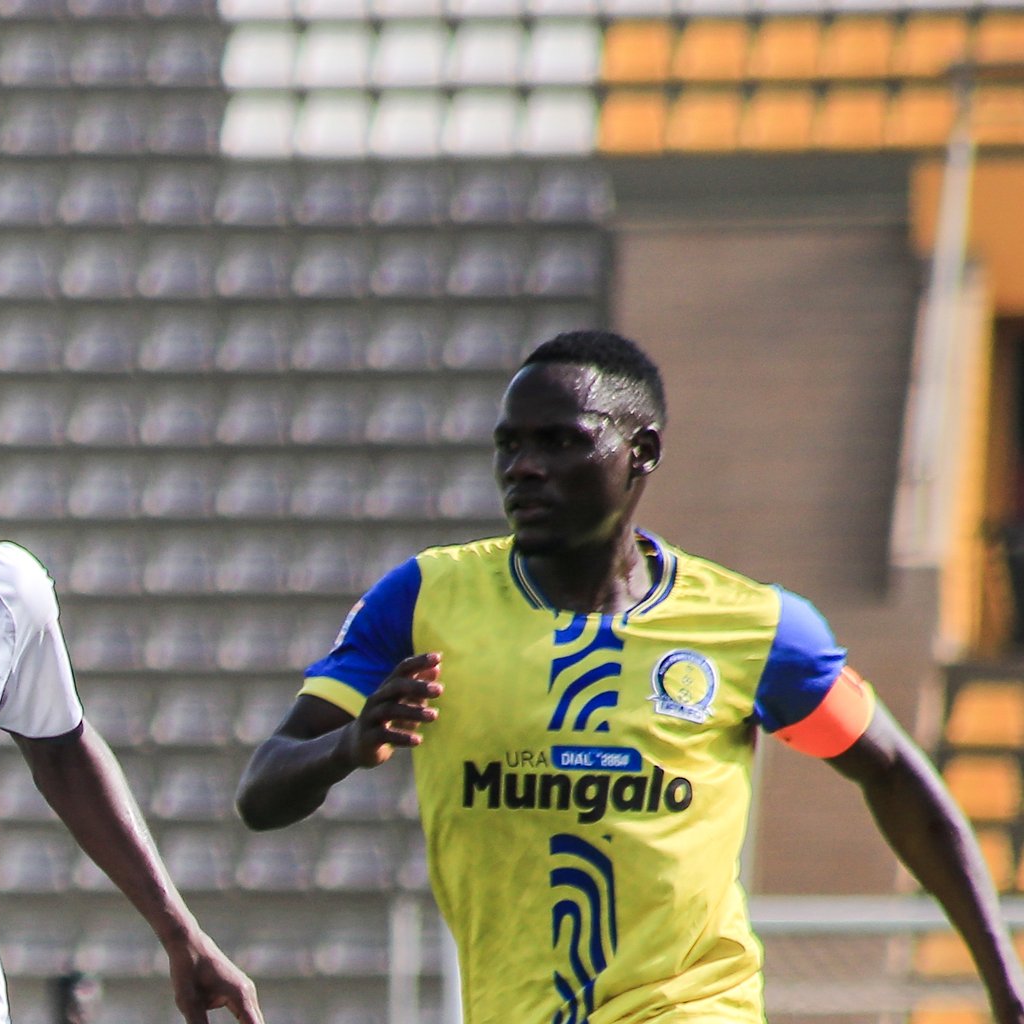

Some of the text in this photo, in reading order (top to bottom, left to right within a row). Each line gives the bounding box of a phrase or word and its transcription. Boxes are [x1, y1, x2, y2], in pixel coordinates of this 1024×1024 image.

[506, 751, 548, 768] URA
[560, 751, 593, 767] DIAL
[462, 760, 693, 825] Mungalo
